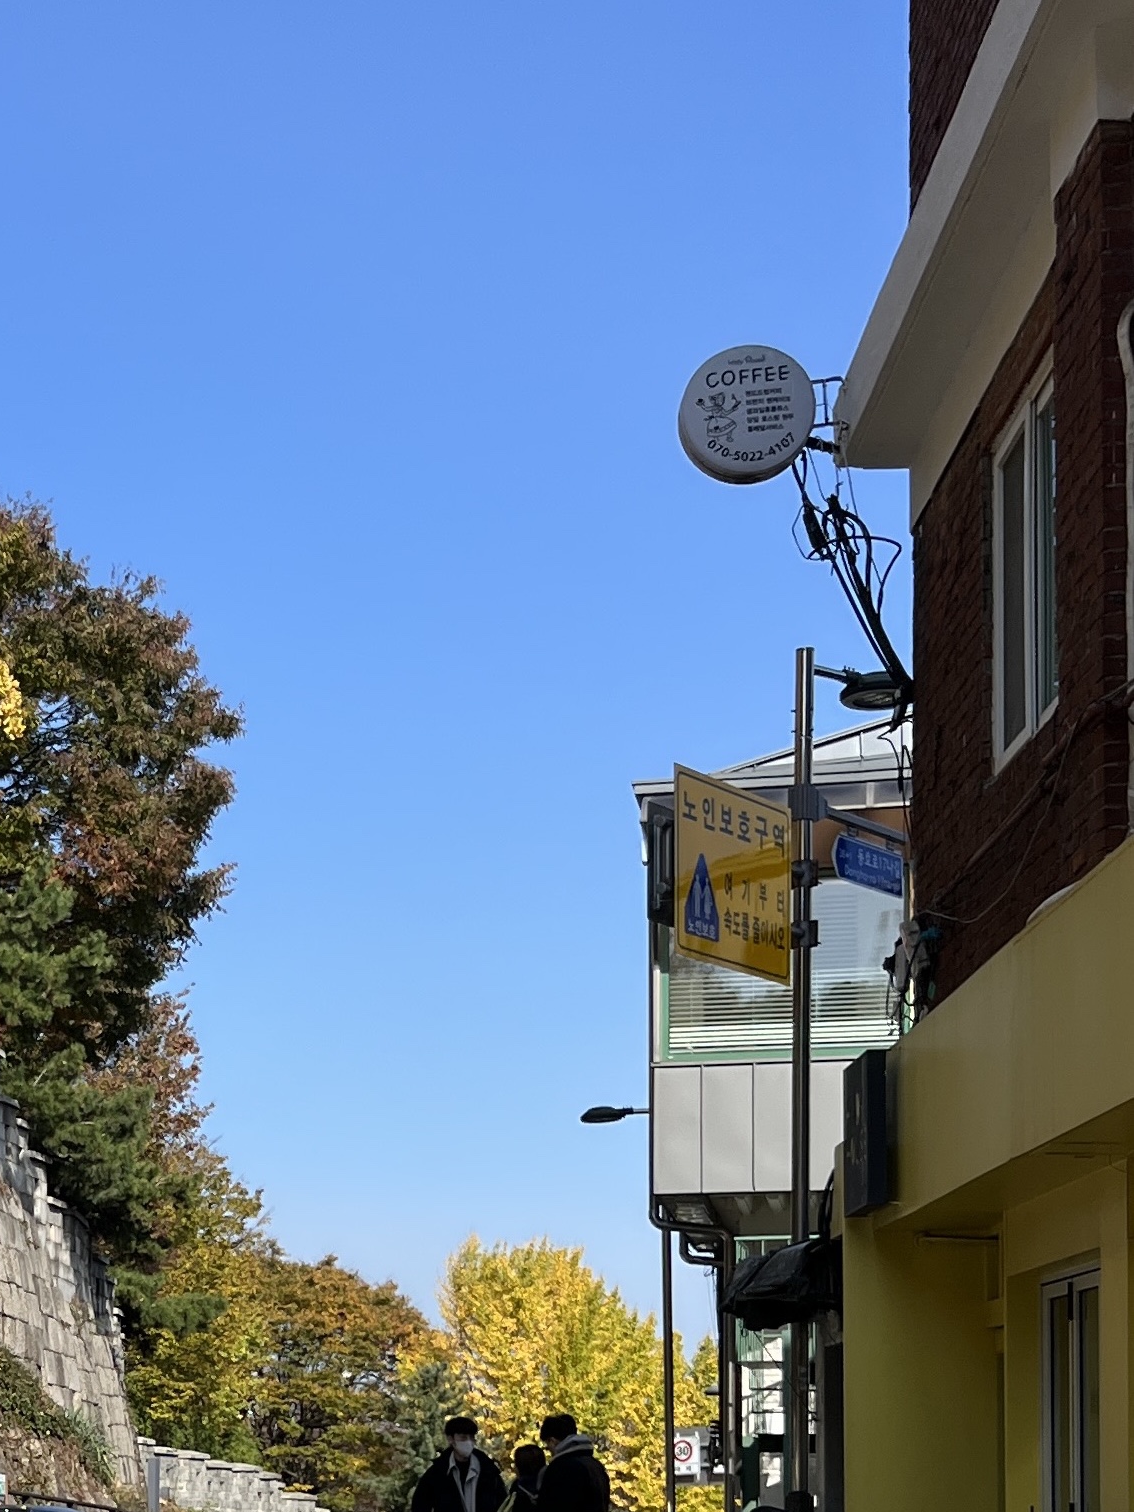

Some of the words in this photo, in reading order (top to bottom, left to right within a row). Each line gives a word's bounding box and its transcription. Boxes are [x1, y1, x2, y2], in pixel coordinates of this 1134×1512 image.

[706, 365, 790, 388] COFFEE
[707, 432, 795, 462] 070-5022-4107
[682, 790, 785, 859] 노인보호구역
[725, 872, 785, 918] 여기부터
[688, 919, 717, 940] 노인보호
[724, 907, 749, 942] 속도를
[752, 916, 785, 950] 줄이시오
[676, 1446, 689, 1457] 30
